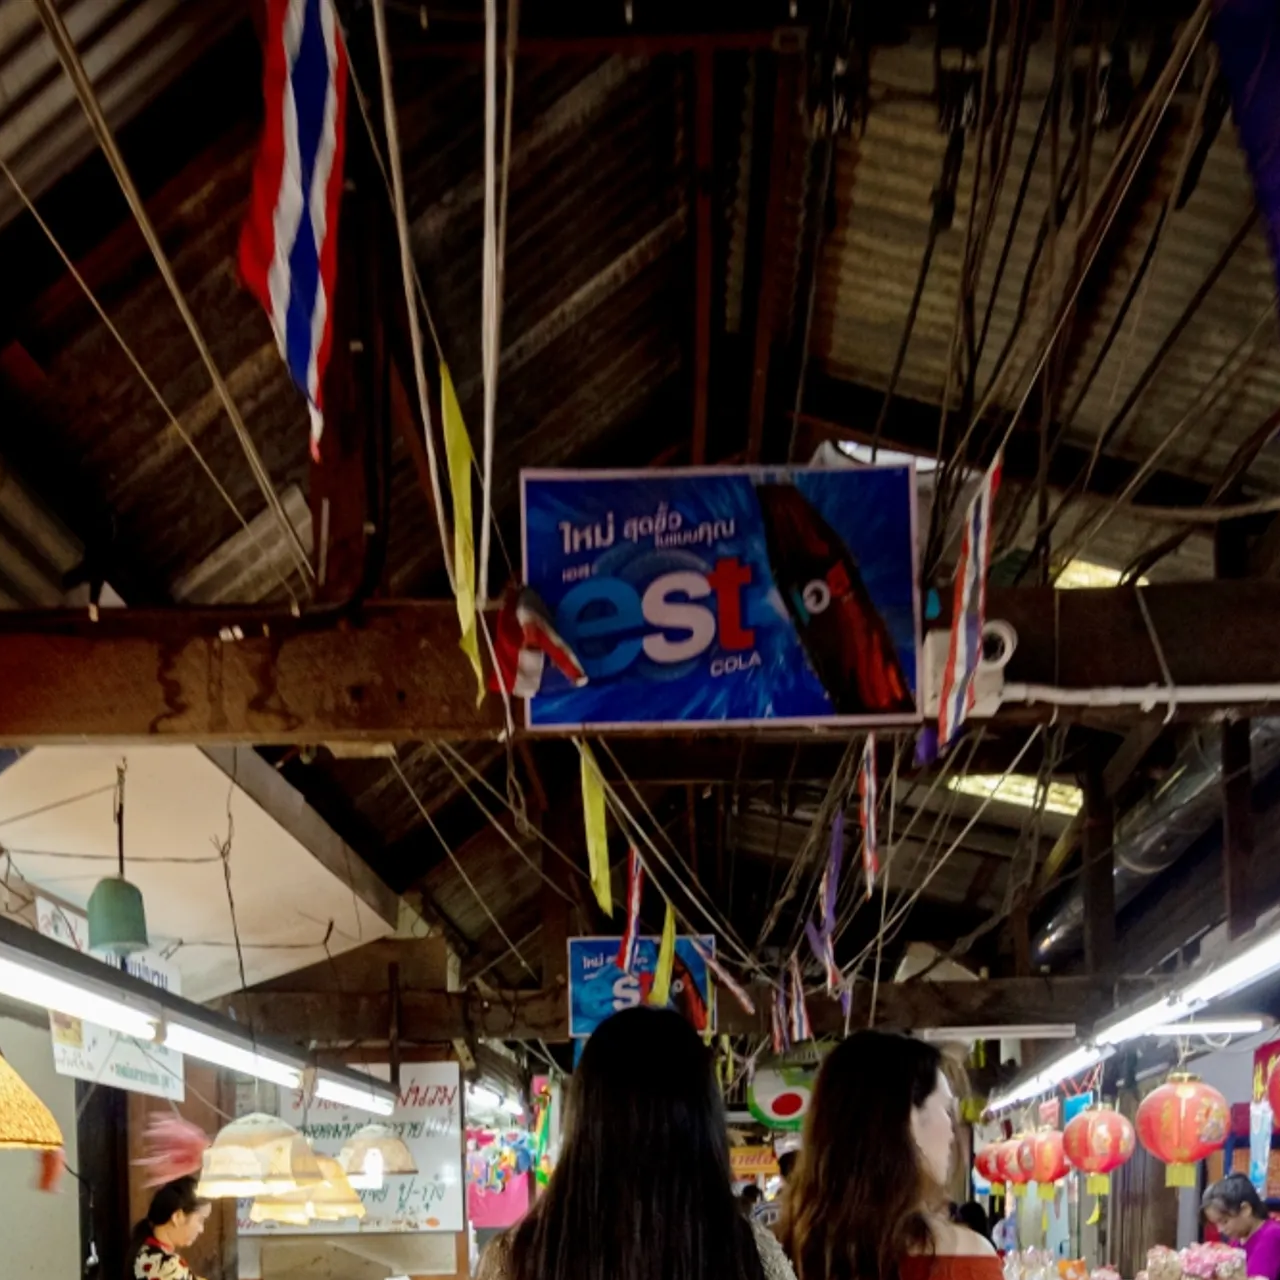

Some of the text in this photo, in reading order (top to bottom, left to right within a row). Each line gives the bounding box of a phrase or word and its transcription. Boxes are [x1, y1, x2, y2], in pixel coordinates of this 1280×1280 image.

[558, 511, 615, 556] ใหม่
[558, 557, 756, 679] est
[710, 651, 763, 678] COLA
